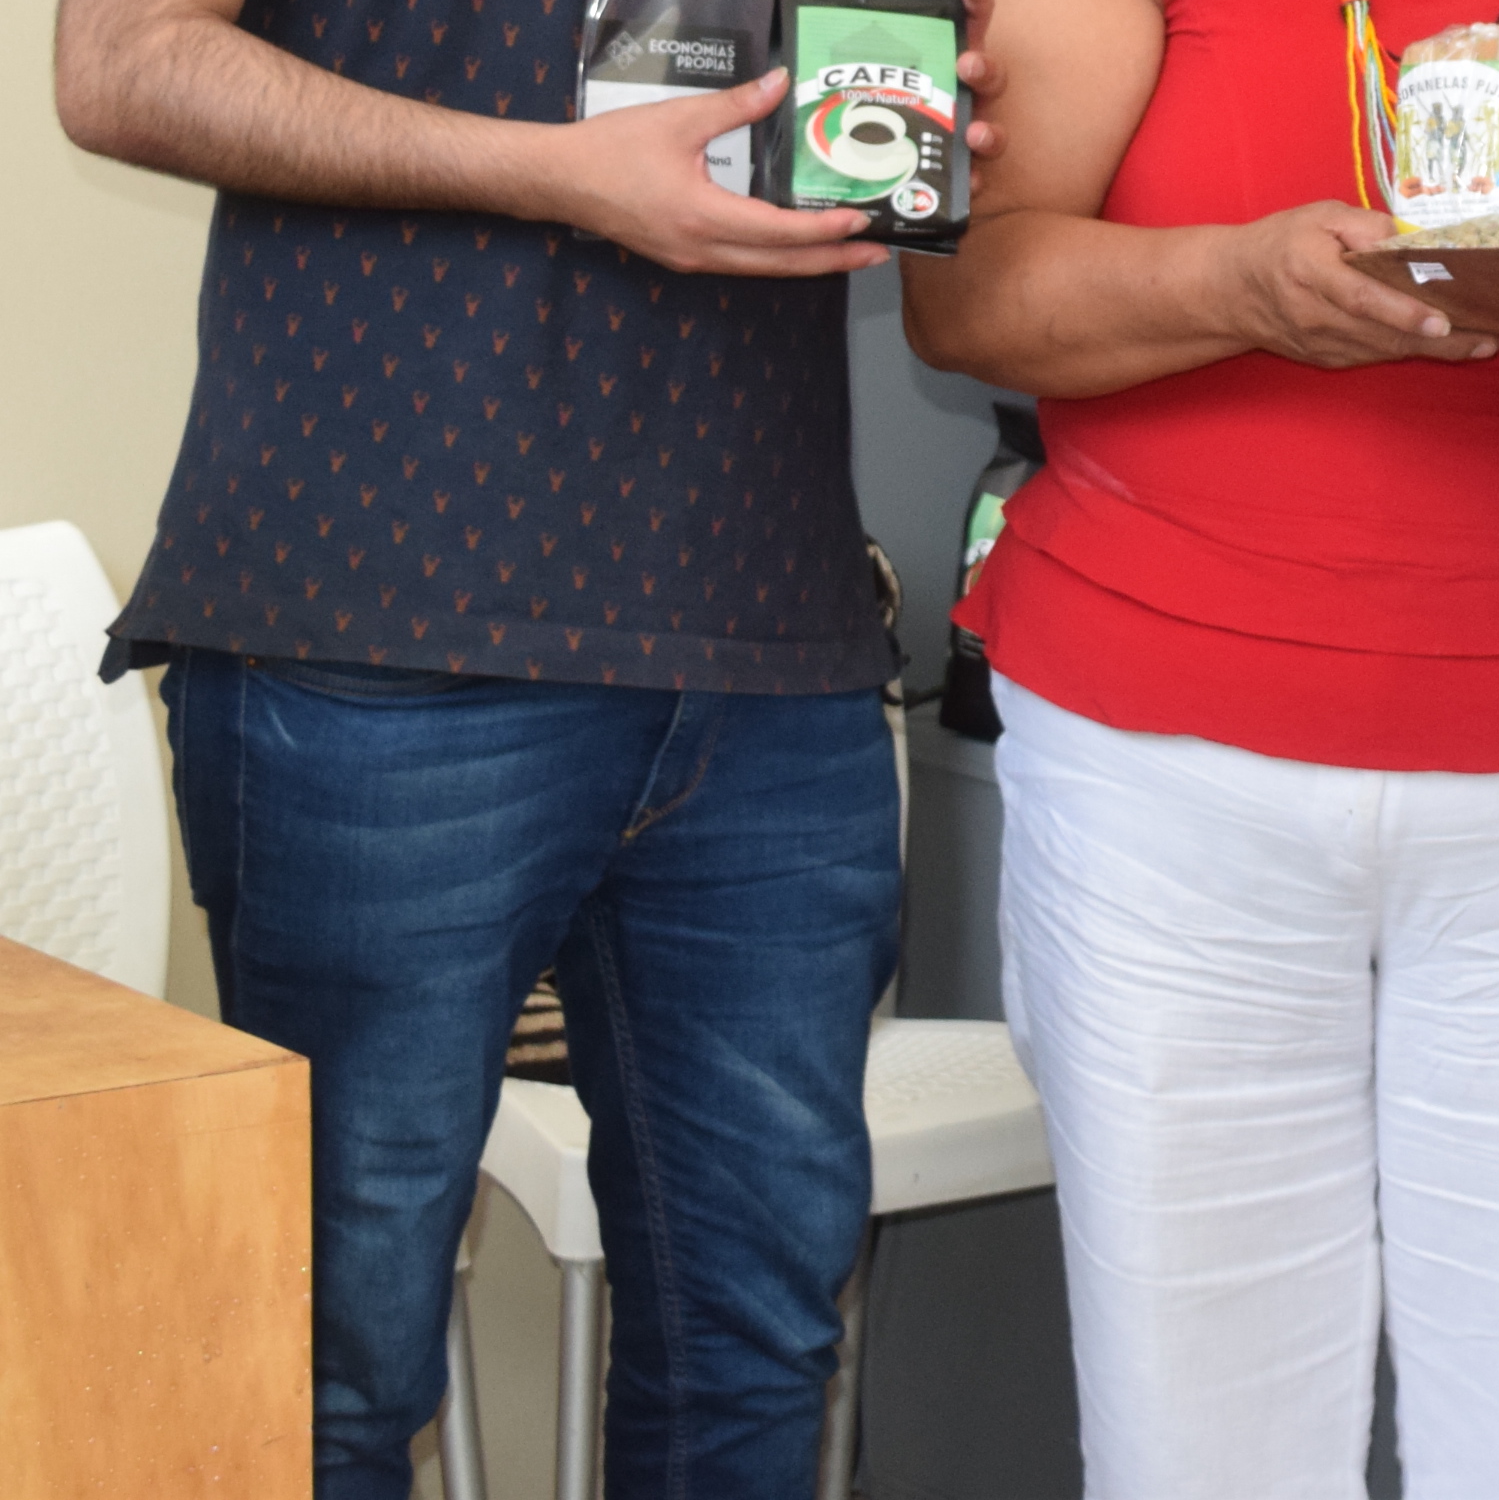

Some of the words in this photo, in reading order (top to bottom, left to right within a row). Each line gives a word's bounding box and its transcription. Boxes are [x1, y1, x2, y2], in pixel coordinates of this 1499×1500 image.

[676, 54, 735, 72] PROPIAS
[840, 89, 874, 103] 100%
[876, 91, 920, 106] Natural
